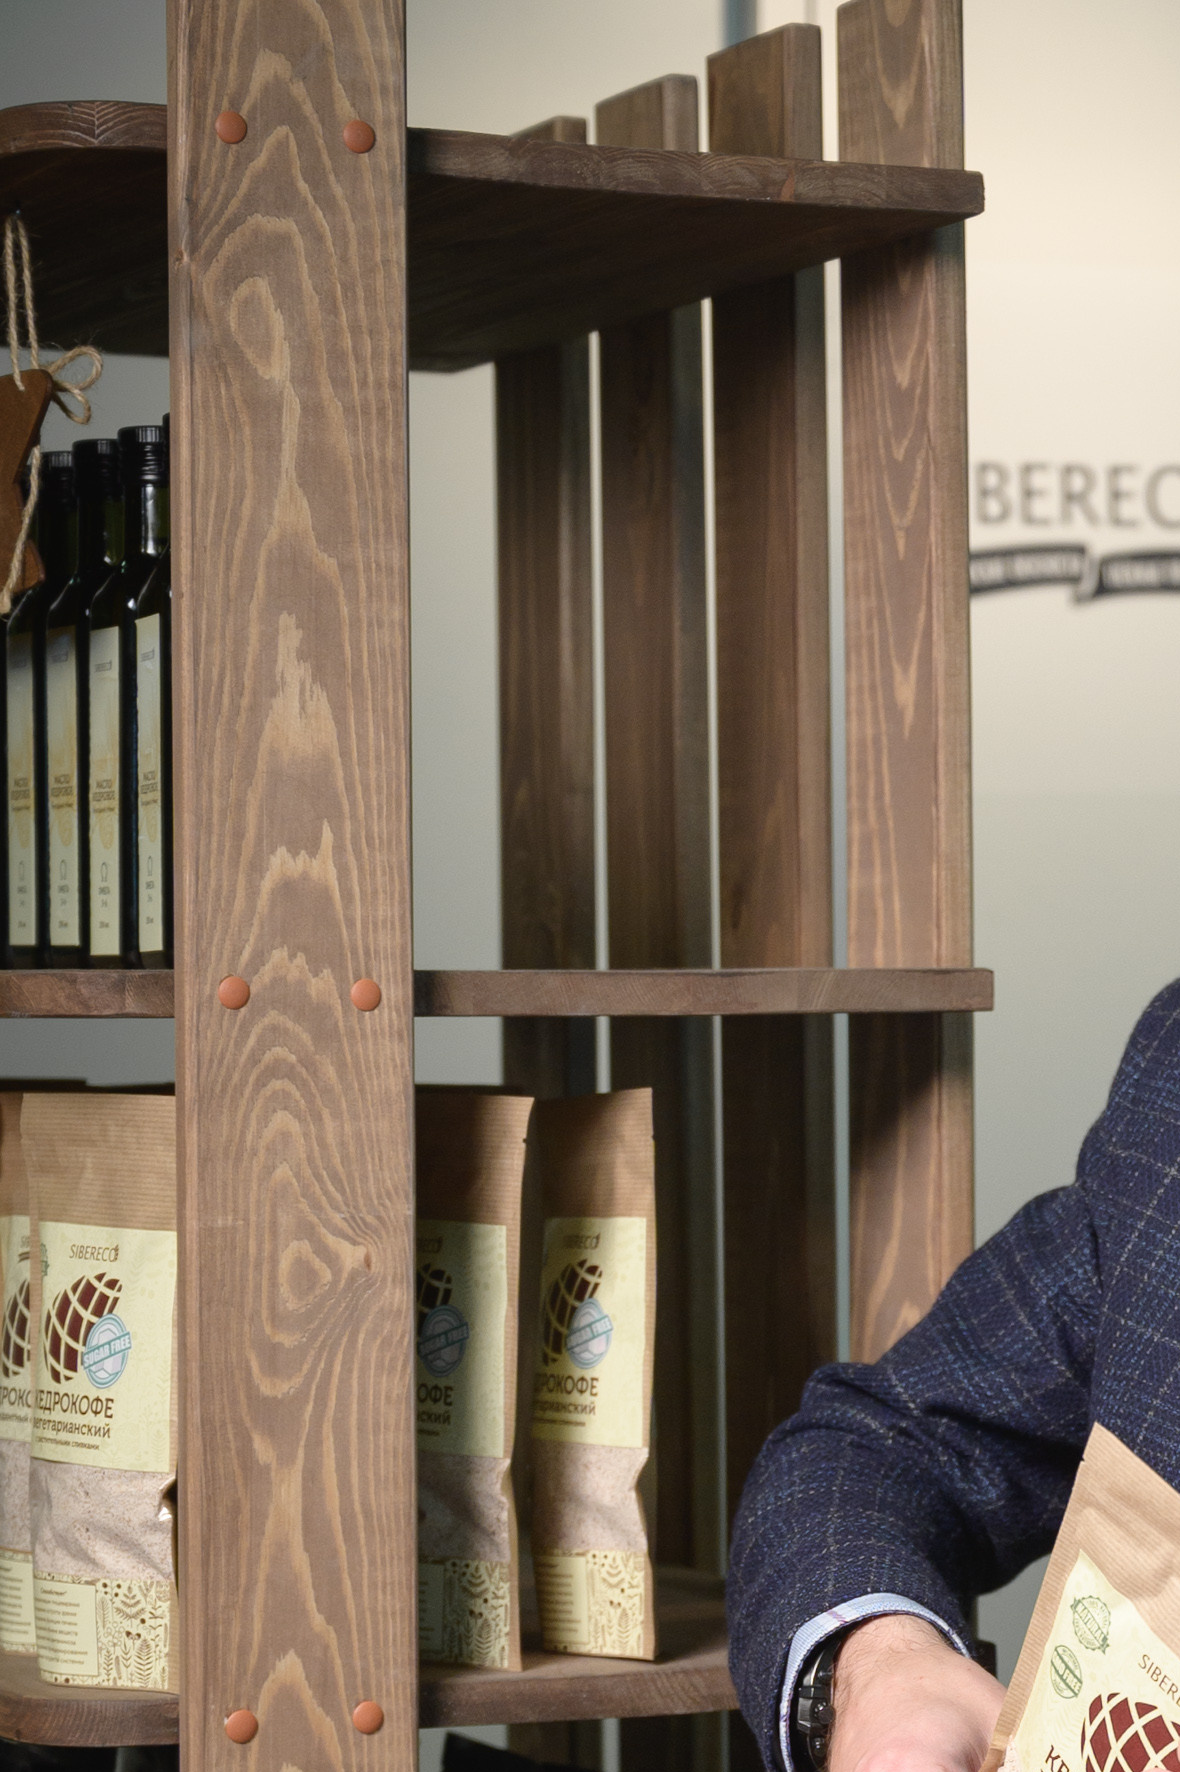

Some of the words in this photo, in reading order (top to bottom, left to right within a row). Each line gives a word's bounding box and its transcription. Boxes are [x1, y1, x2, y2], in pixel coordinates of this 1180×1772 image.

[69, 1244, 119, 1263] SIBERECO
[84, 1345, 110, 1366] SUGAR
[110, 1333, 132, 1353] FREE
